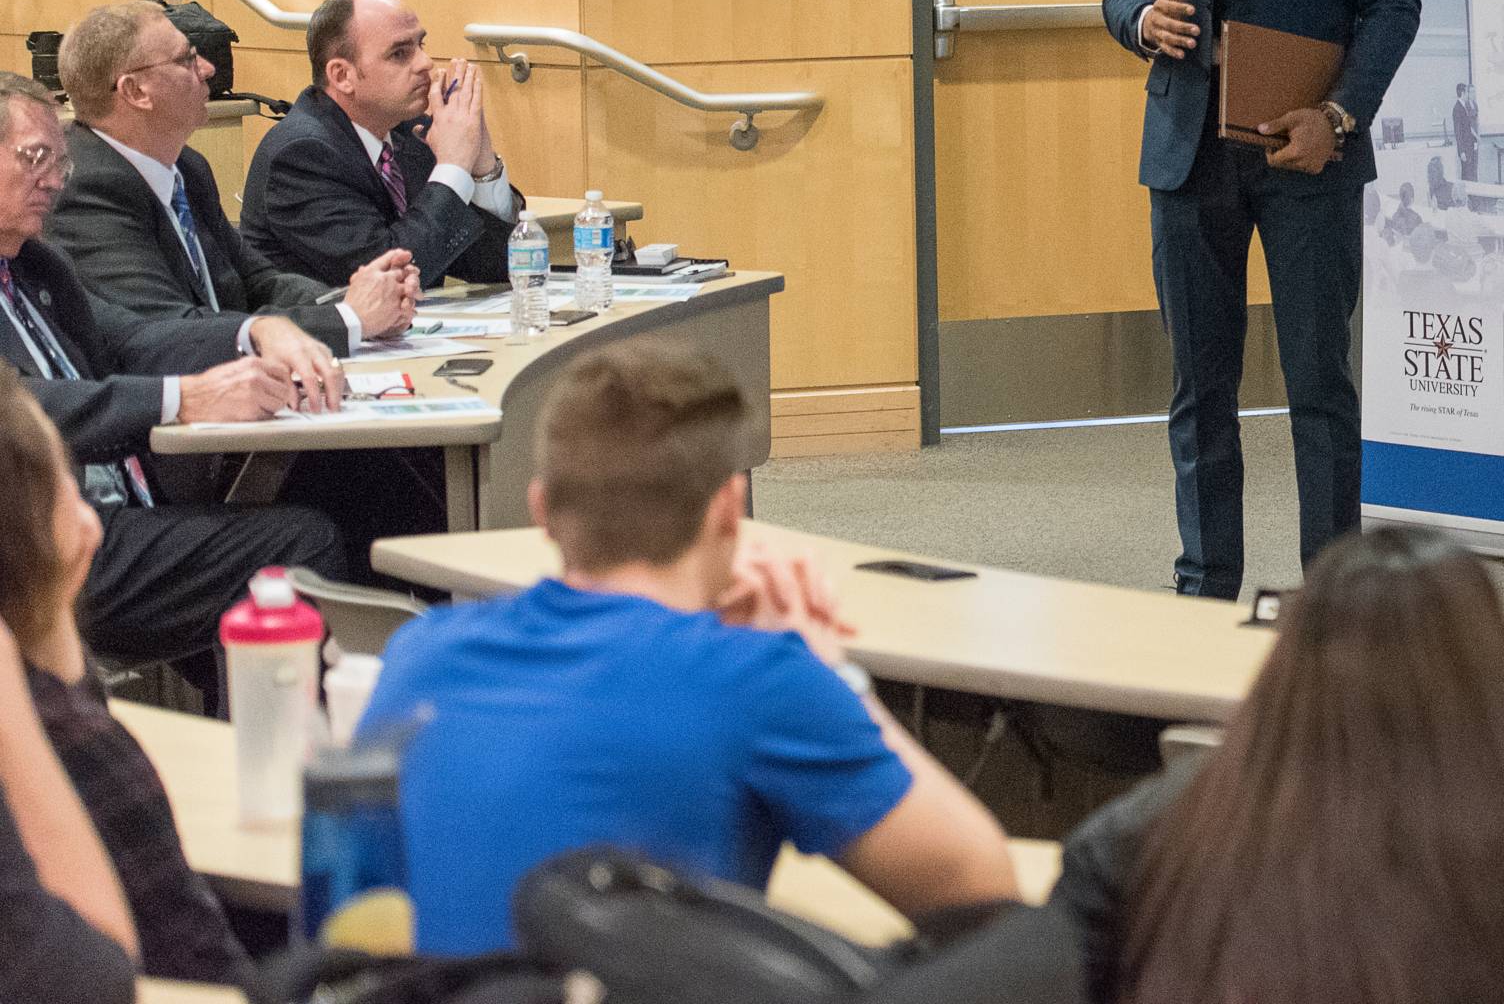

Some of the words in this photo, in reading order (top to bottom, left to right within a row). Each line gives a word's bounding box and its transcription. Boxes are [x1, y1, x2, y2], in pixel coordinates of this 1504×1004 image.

[1403, 311, 1483, 344] TEXAS
[1405, 349, 1483, 383] STATE
[1410, 379, 1478, 397] UNIVERSITY
[1438, 407, 1455, 415] STAR
